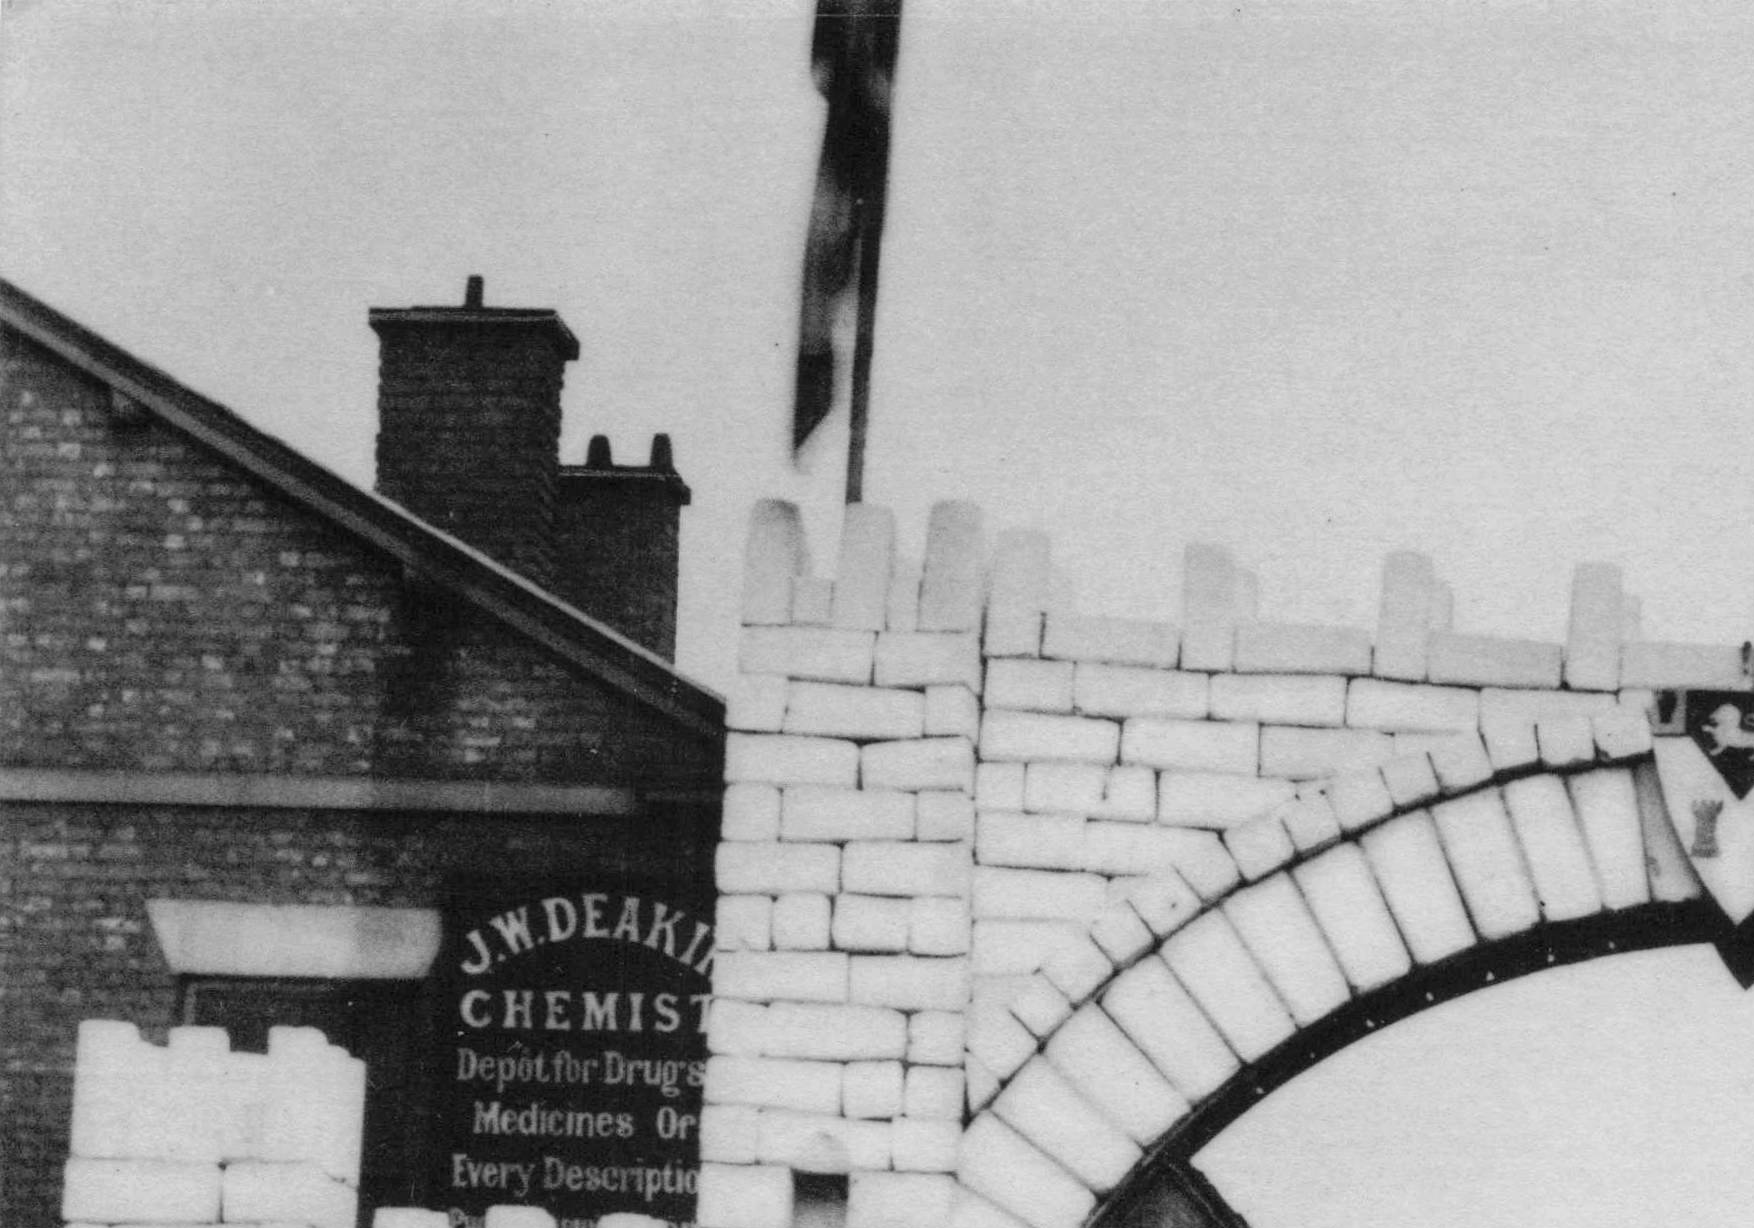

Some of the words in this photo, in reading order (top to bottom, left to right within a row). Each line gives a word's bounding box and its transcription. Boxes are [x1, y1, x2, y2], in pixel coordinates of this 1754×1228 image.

[460, 989, 712, 1033] CHEMIST
[552, 1049, 599, 1084] for
[604, 1050, 705, 1098] Drugs
[473, 1101, 634, 1138] Medicines
[451, 1153, 535, 1198] Every
[543, 1155, 699, 1202] Descriptio
